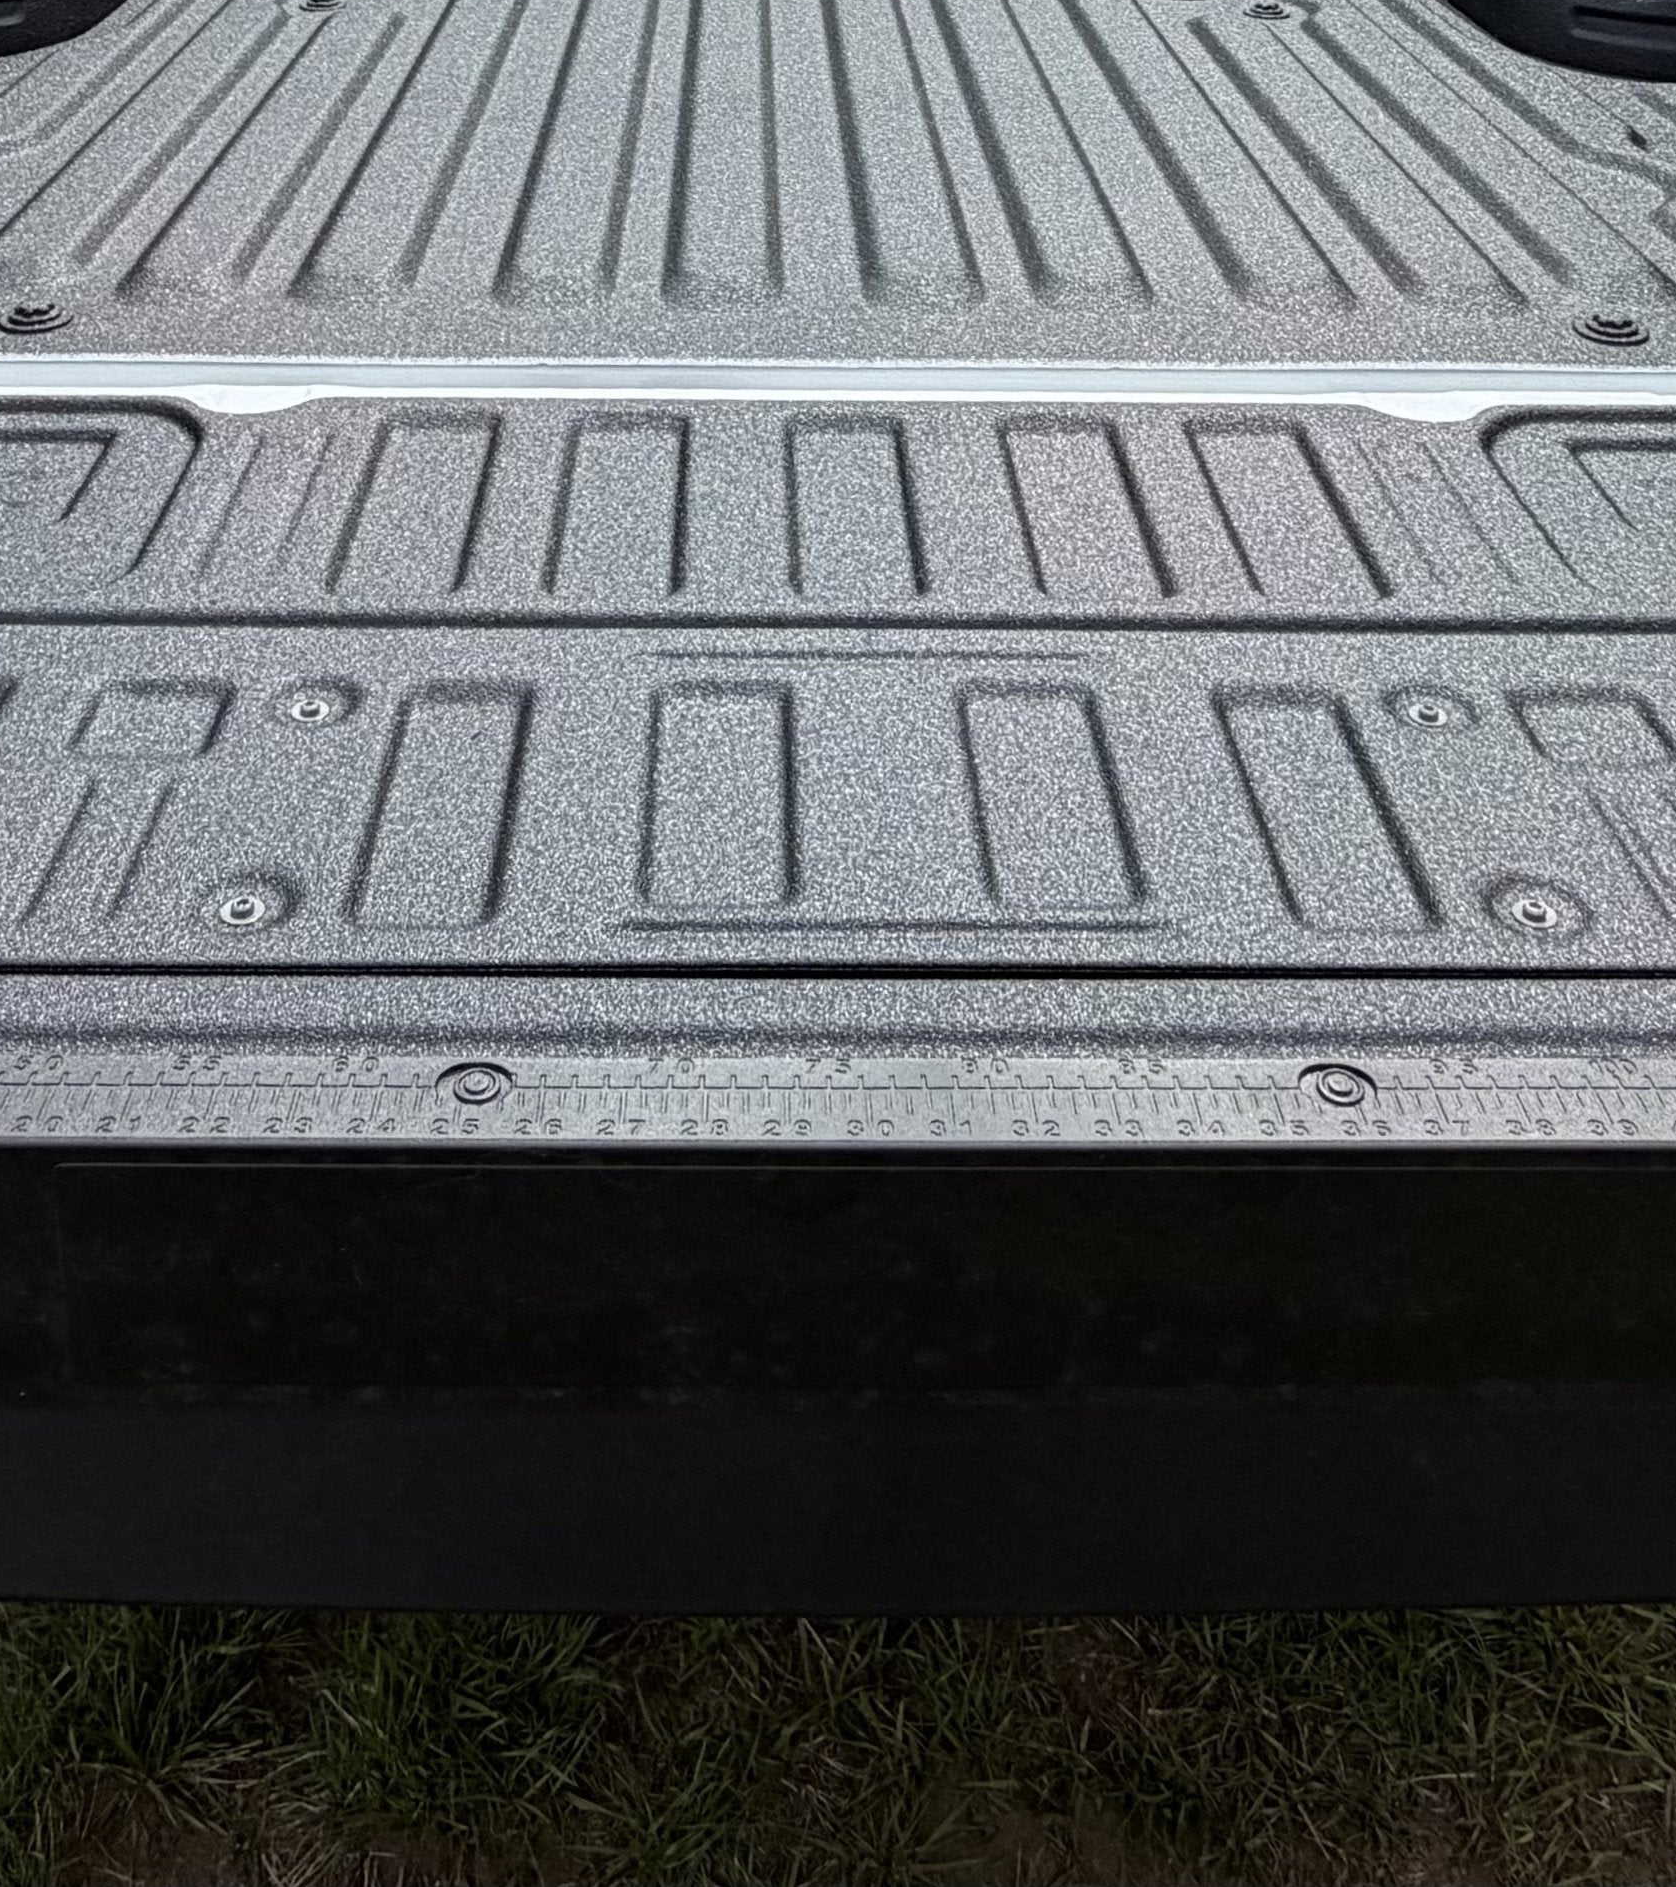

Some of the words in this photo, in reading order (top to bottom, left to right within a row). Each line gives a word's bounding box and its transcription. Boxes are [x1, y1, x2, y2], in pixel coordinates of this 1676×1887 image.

[11, 1115, 64, 1133] 20
[180, 1116, 230, 1133] 22
[263, 1116, 314, 1134] 23
[345, 1117, 396, 1134] 24
[430, 1117, 480, 1134] 25
[513, 1118, 563, 1135] 26
[596, 1118, 646, 1135] 27
[680, 1118, 728, 1135] 28
[763, 1118, 811, 1135] 29
[847, 1119, 894, 1136] 30
[928, 1119, 972, 1136] 31
[1012, 1119, 1060, 1136] 32
[1094, 1119, 1143, 1136] 33
[1176, 1119, 1224, 1136] 34
[1259, 1119, 1309, 1136] 35
[1341, 1119, 1391, 1136] 36
[1423, 1119, 1470, 1136] 37
[1505, 1119, 1557, 1136] 38
[1587, 1119, 1639, 1136] 39
